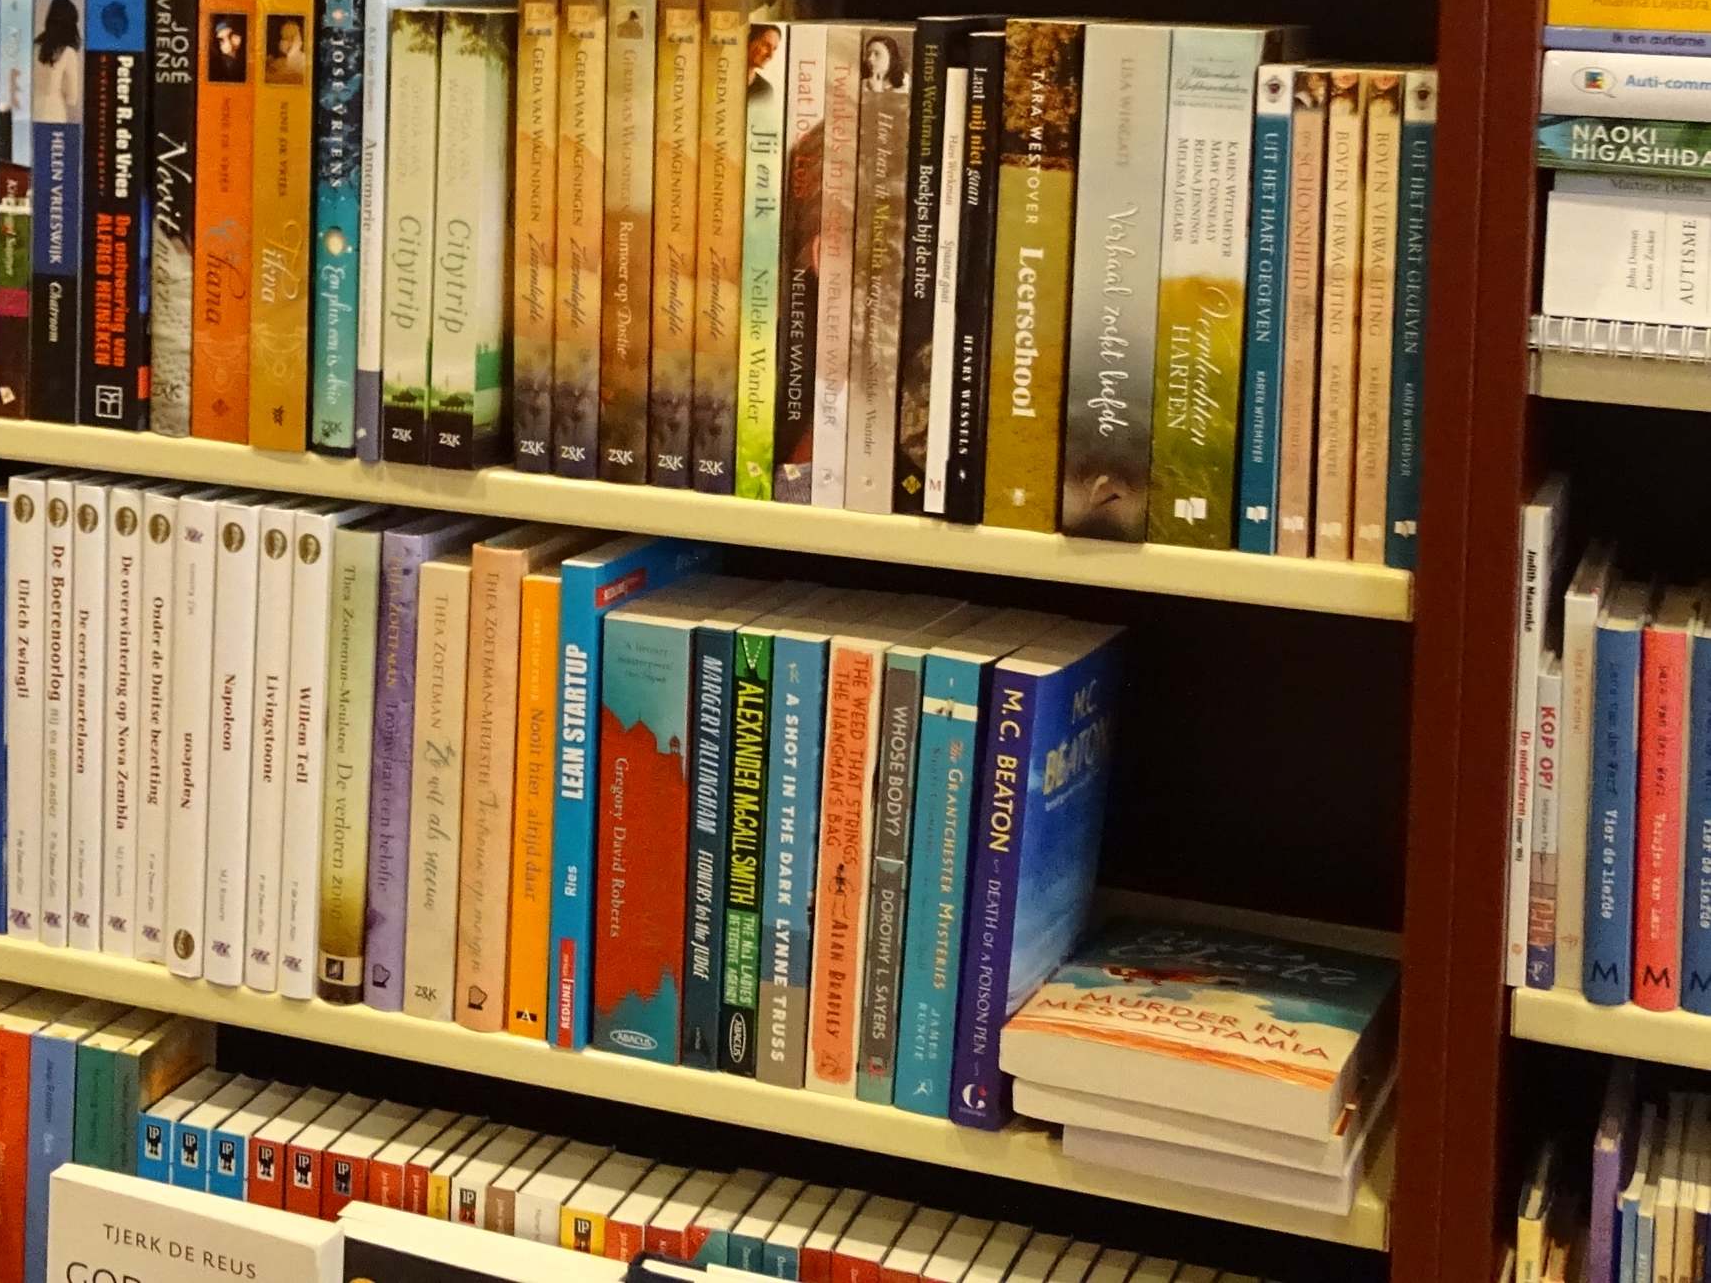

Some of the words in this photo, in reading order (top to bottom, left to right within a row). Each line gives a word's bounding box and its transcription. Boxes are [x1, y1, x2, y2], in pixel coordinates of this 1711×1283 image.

[116, 55, 134, 103] Peter
[170, 19, 190, 85] JOSÉ
[115, 107, 133, 125] R.
[1031, 71, 1044, 126] TARA
[50, 131, 64, 176] HELEN
[115, 129, 129, 149] de
[1572, 125, 1656, 144] NAOKI
[1572, 146, 1711, 167] HIGASHIDA
[114, 152, 132, 198] Vries
[1025, 128, 1043, 224] WESTOVER
[48, 177, 63, 263] VREESWIJK
[1104, 205, 1139, 300] Verhaal
[1680, 220, 1696, 304] AUTISME
[46, 282, 62, 342] Chatroom
[1012, 247, 1044, 417] Leerschool
[1099, 307, 1122, 365] zoekt
[1090, 372, 1128, 436] liefde
[1168, 325, 1191, 431] HARTEN
[51, 545, 65, 568] De
[18, 579, 31, 628] Ulrich
[15, 635, 31, 699] Zwingli
[48, 573, 65, 702] Boerenoorlog
[221, 673, 236, 752] Napoleon
[298, 686, 312, 747] Willem
[562, 643, 588, 733] STARTUP
[700, 655, 723, 741] MARGERY
[786, 692, 800, 706] A
[784, 714, 799, 767] SHOT
[890, 706, 910, 771] WHOSE
[1540, 705, 1556, 754] KOP
[296, 753, 310, 785] Tell
[562, 738, 585, 800] LEAN
[614, 756, 630, 820] Gregory
[696, 744, 720, 834] ALLINGHAM
[783, 774, 798, 798] IN
[1539, 757, 1555, 792] OP!
[780, 806, 796, 852] THE
[886, 773, 905, 837] BODY?
[612, 823, 626, 871] David
[565, 865, 578, 897] Ries
[610, 876, 626, 939] Roberts
[778, 857, 795, 905] DARK
[774, 918, 790, 986] LYNNE
[771, 996, 787, 1062] TRUSS
[1036, 999, 1330, 1060] MESOPOTAMIA
[1080, 990, 1240, 1029] MURDER
[1250, 1022, 1301, 1040] IN
[103, 1224, 161, 1254] TJERK
[169, 1243, 194, 1261] DE
[201, 1251, 256, 1280] REUS
